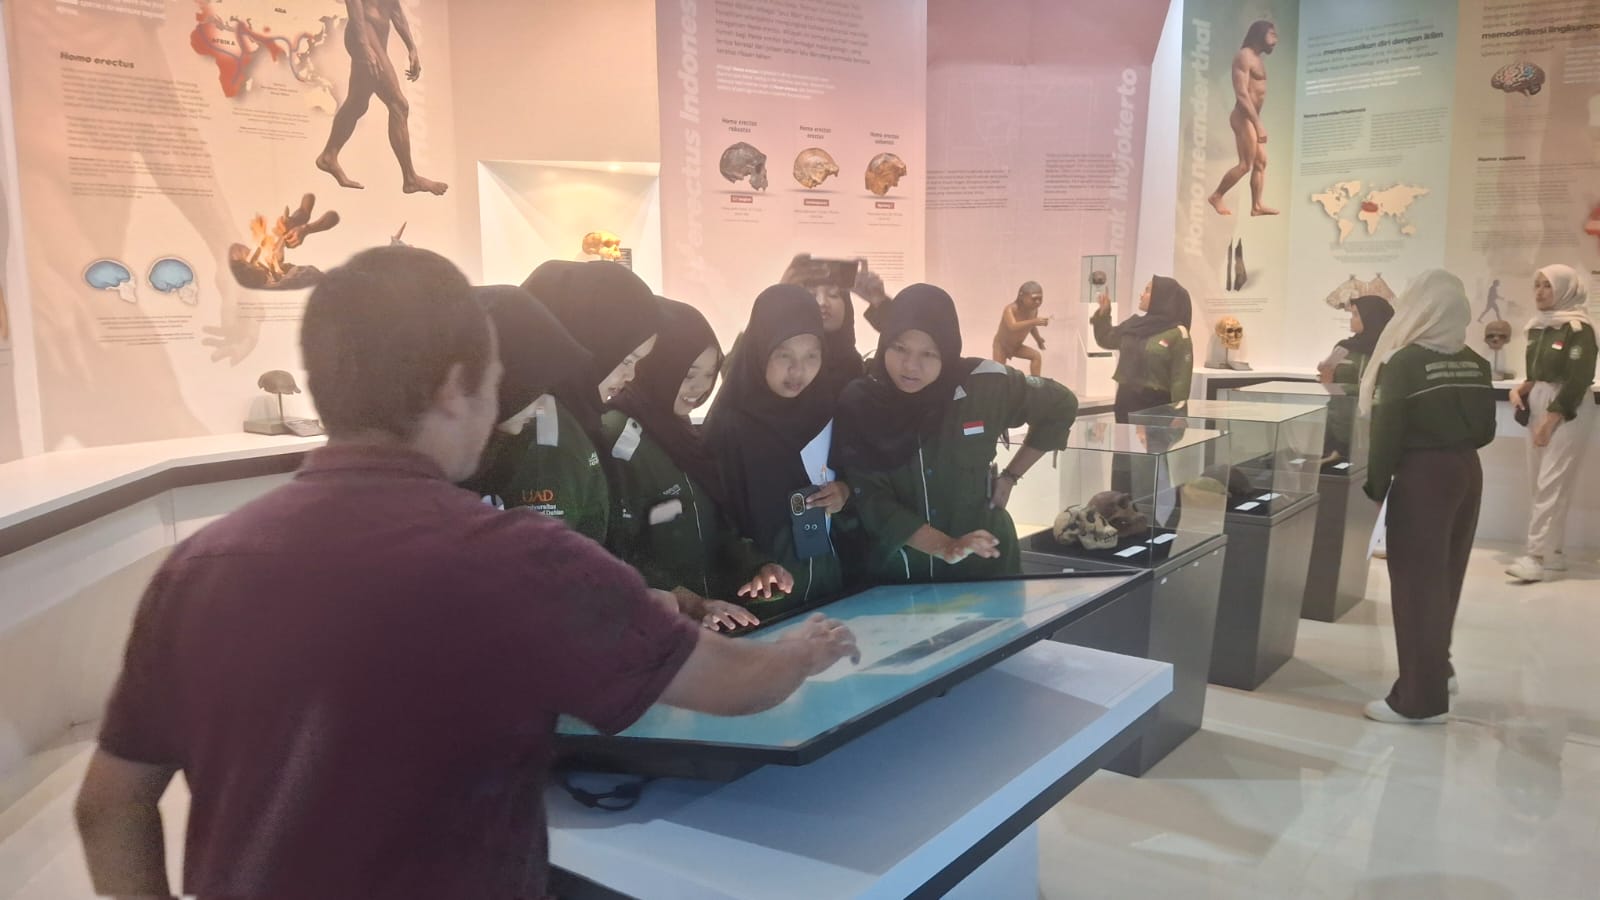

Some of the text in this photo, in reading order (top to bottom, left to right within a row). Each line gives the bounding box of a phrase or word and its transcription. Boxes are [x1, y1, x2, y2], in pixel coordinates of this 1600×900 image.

[60, 52, 135, 69] Homo erectus
[1183, 18, 1212, 257] Homo neanderthal
[522, 489, 554, 502] UAD
